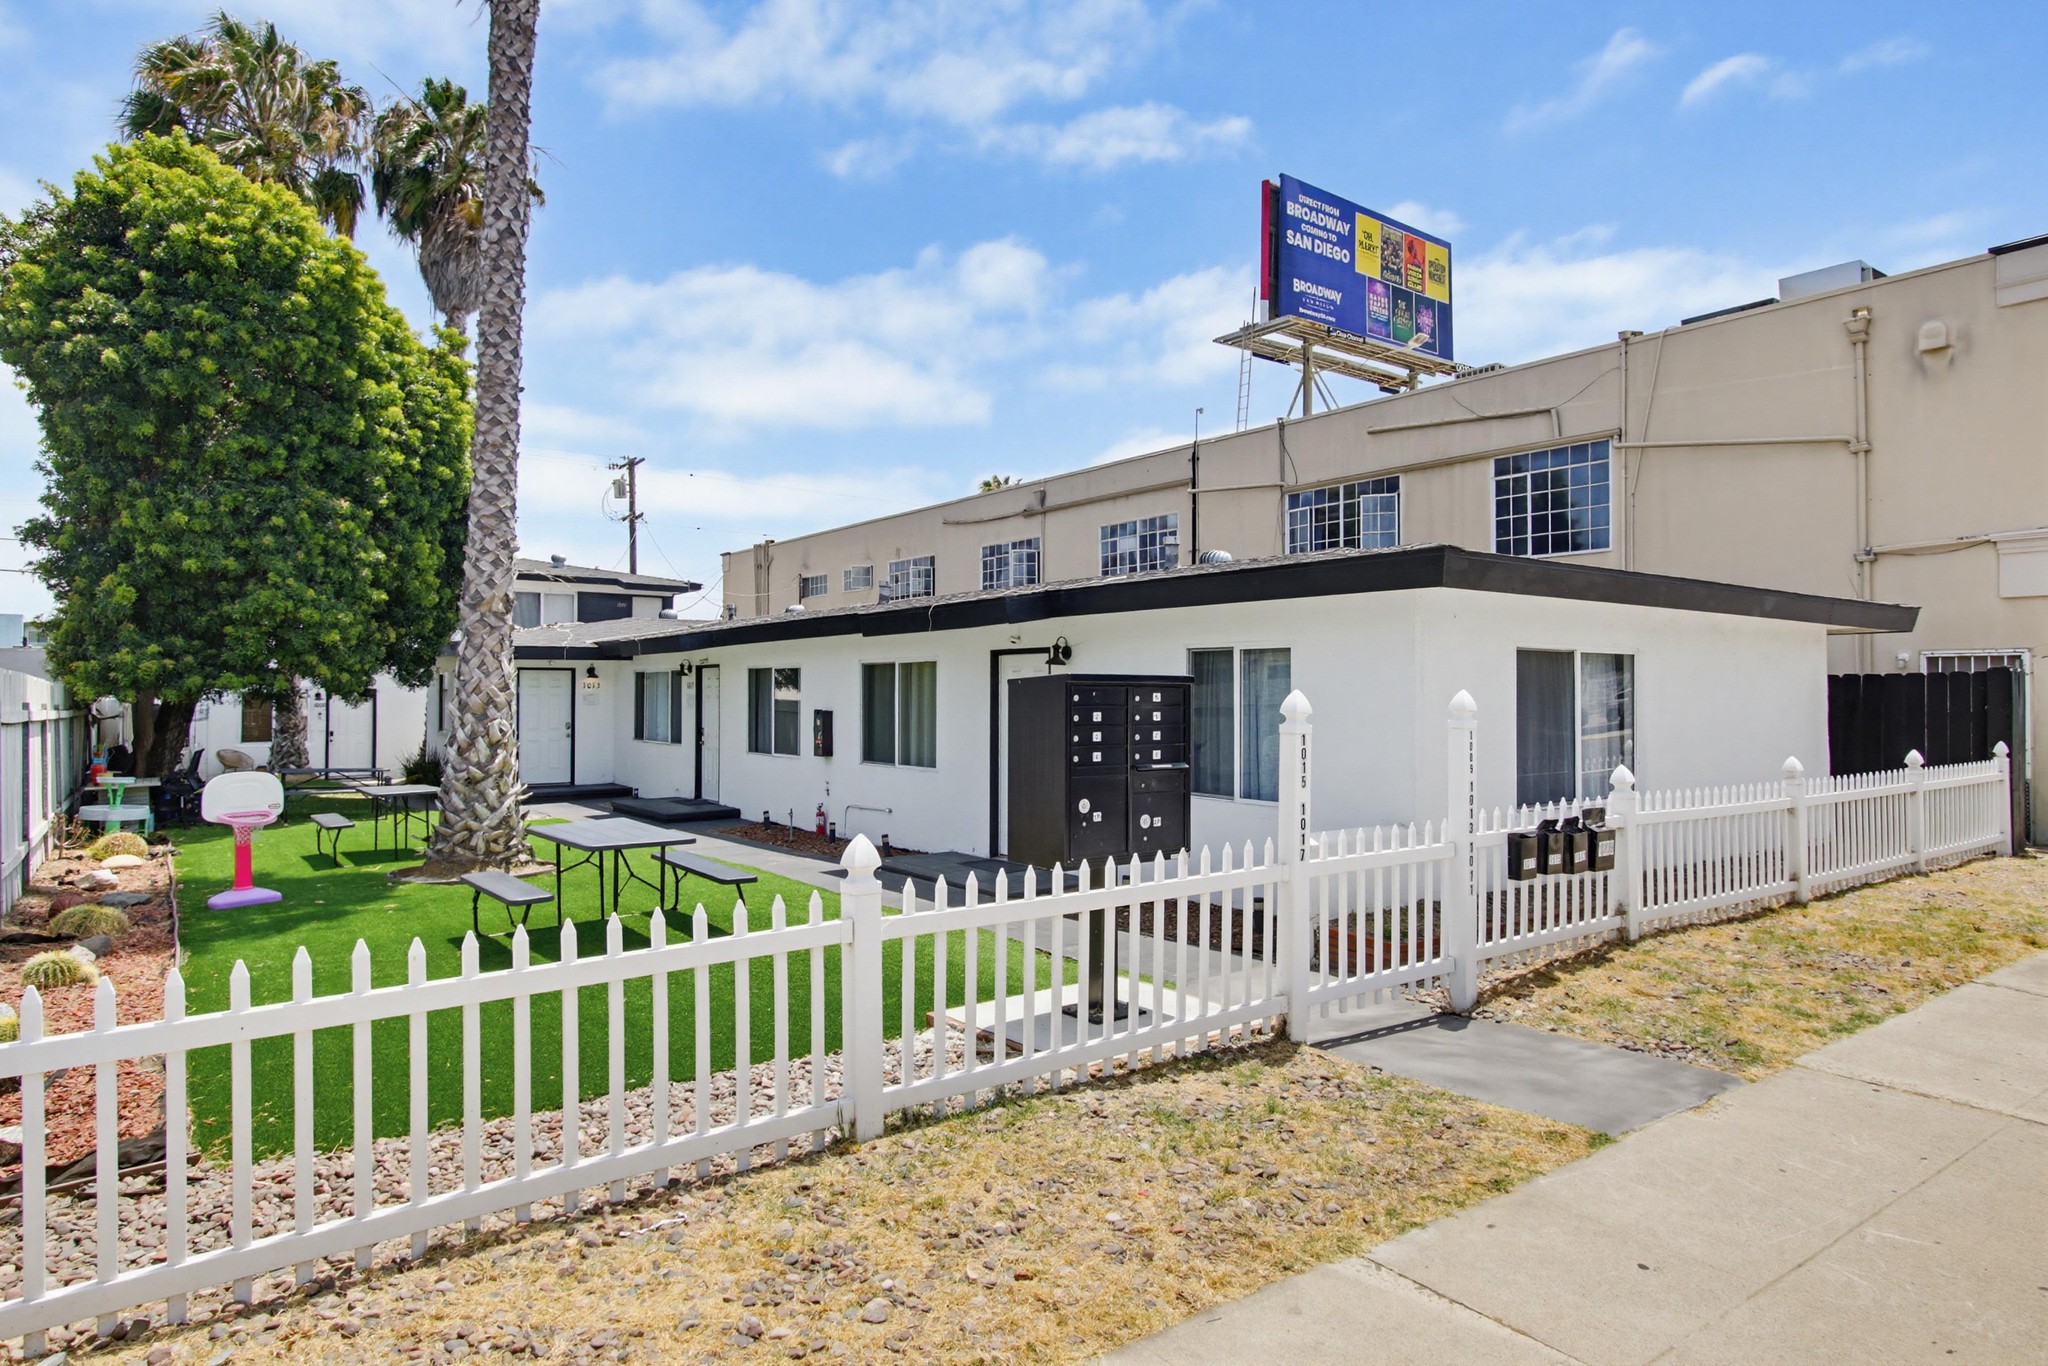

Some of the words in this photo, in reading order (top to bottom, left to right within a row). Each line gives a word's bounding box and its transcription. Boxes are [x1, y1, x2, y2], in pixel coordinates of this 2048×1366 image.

[1286, 200, 1351, 236] BROADWAY
[1298, 193, 1321, 210] DIRECT
[1321, 203, 1340, 217] FROM
[1286, 229, 1312, 251] SAN
[1314, 238, 1351, 263] DIEGO
[1301, 223, 1328, 239] COMING
[1328, 233, 1338, 242] TO
[1293, 278, 1342, 305] BROADWAY
